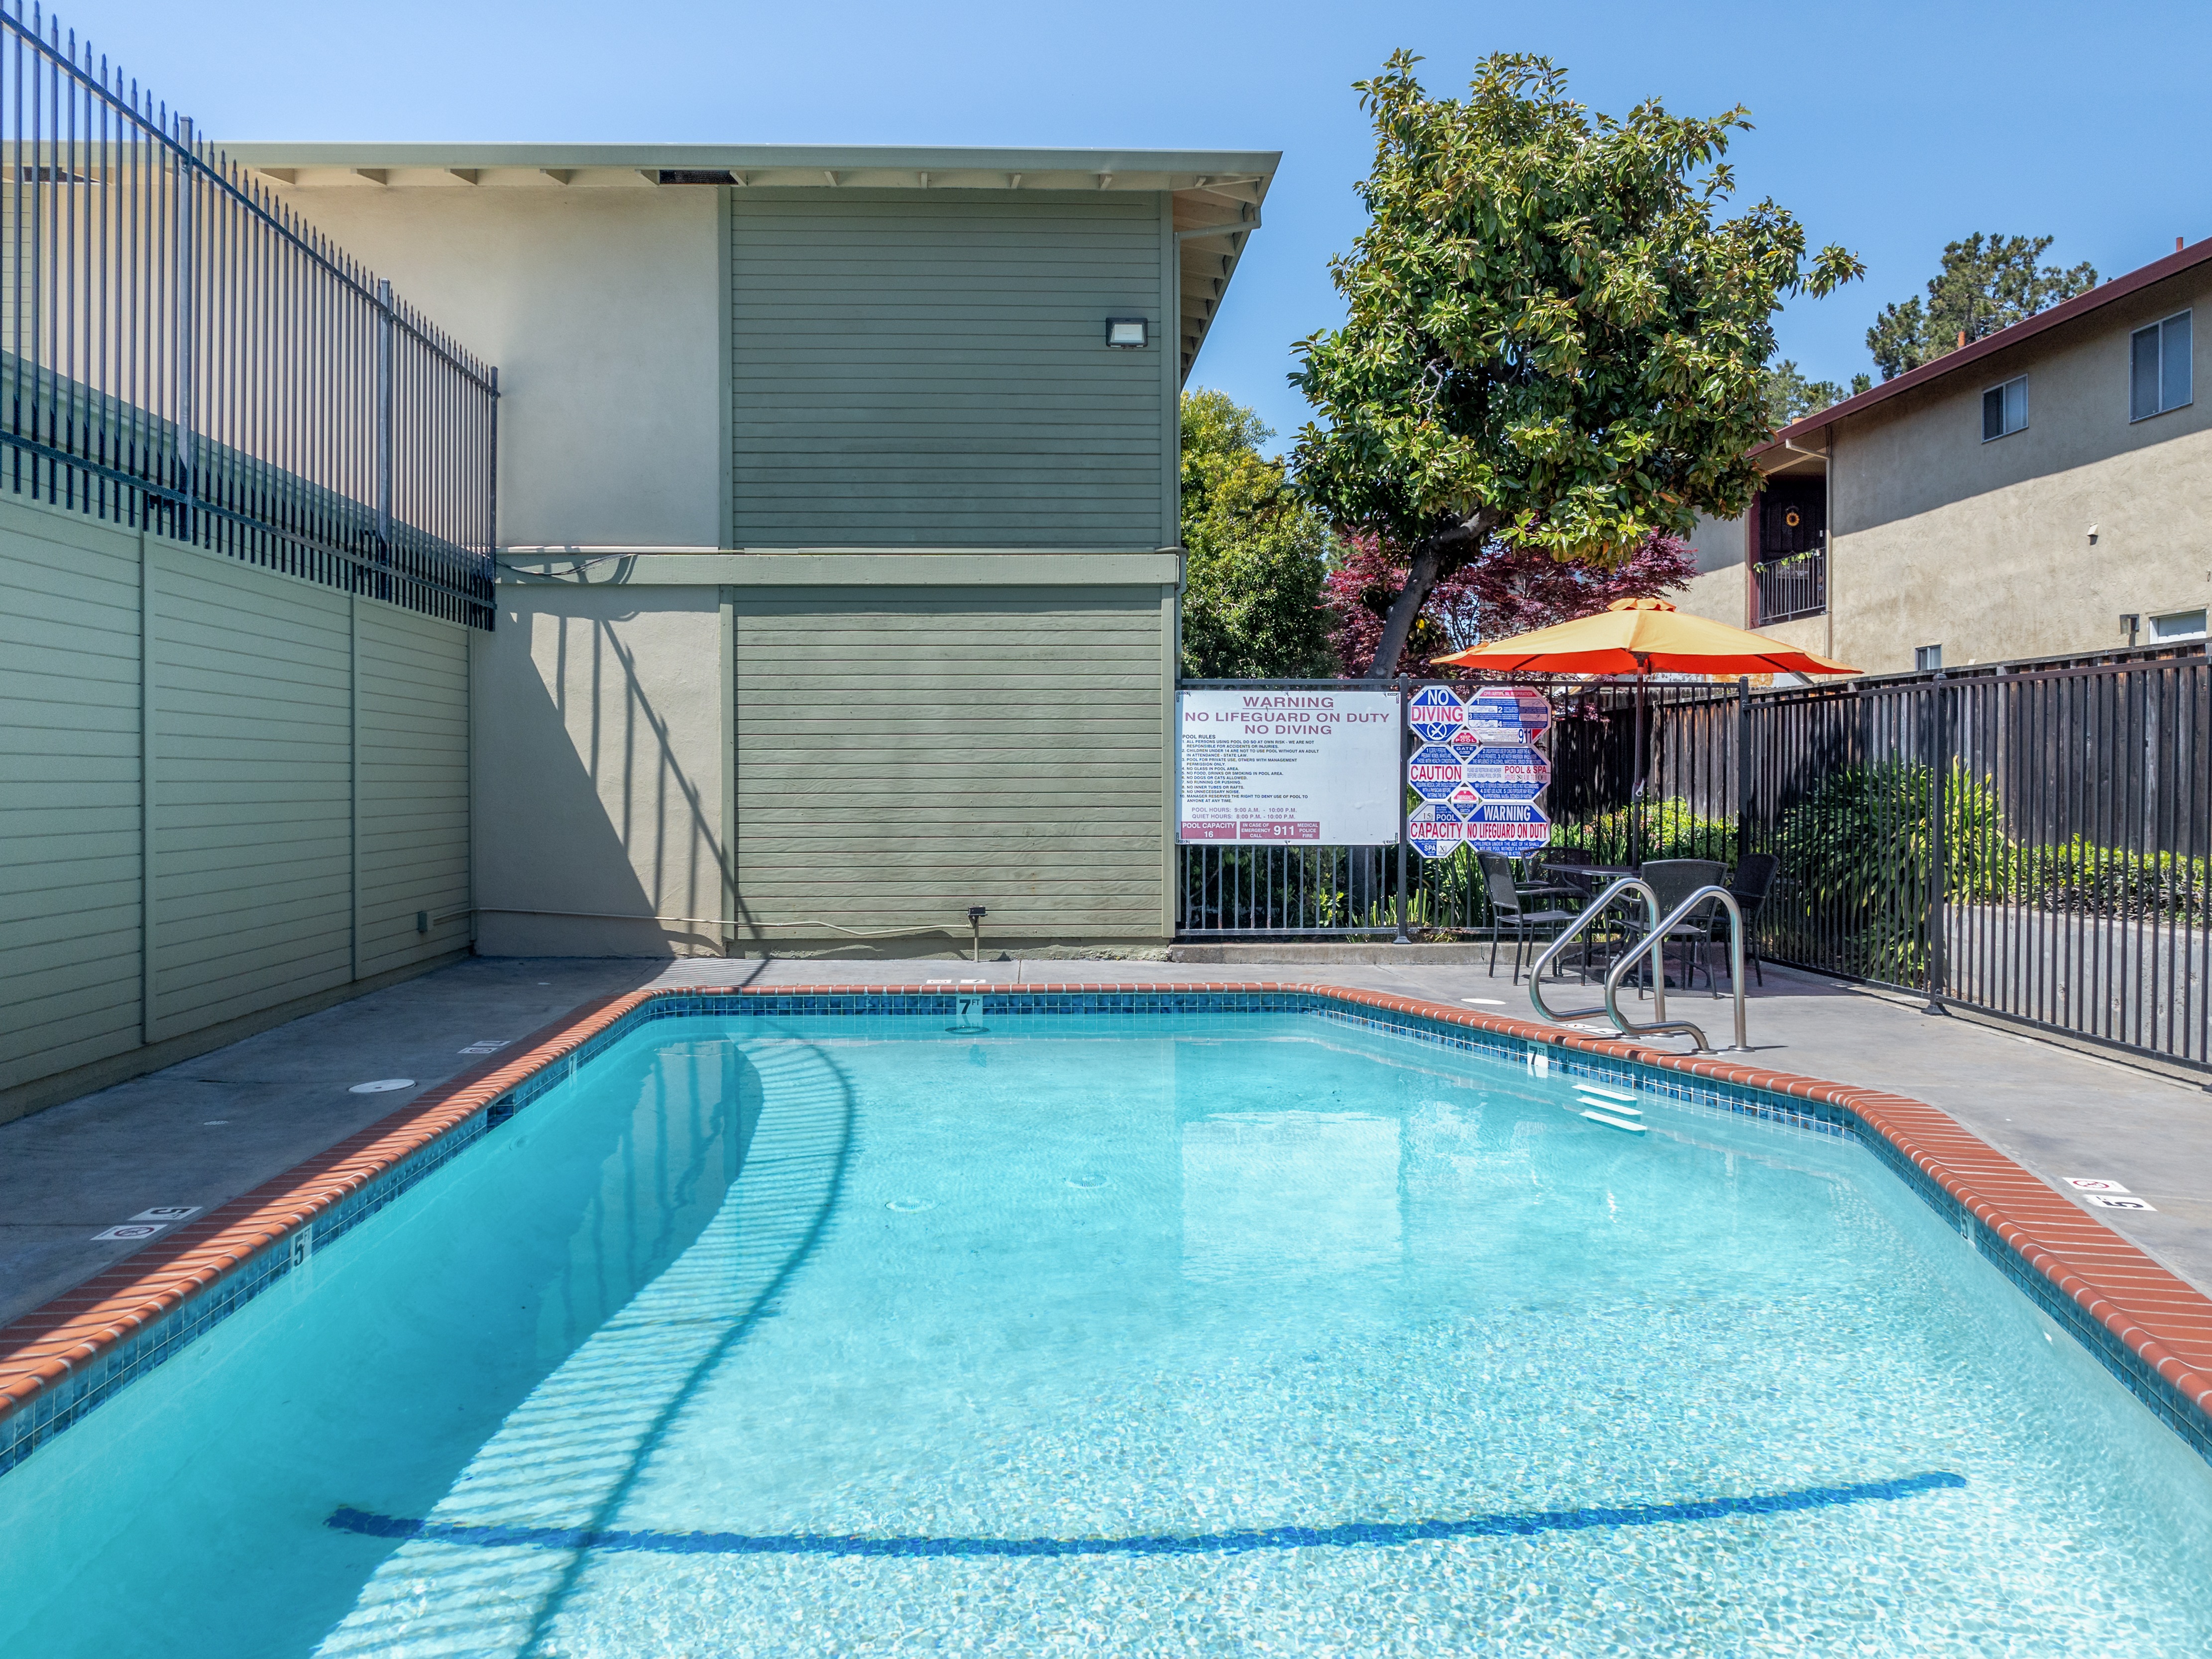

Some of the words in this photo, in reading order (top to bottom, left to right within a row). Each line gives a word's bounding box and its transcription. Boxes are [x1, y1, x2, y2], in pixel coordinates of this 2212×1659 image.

[1243, 697, 1333, 708] WARNING
[1428, 690, 1449, 705] NO
[1186, 712, 1209, 721] NO
[1216, 712, 1310, 722] LIFEGUARD
[1317, 713, 1340, 722] ON
[1347, 713, 1389, 722] DUTY
[1412, 707, 1463, 722] DIVING
[1245, 725, 1269, 734] NO
[1276, 725, 1331, 734] DIVING
[1519, 729, 1532, 744] 911
[1411, 766, 1461, 780] CAUTION
[1484, 806, 1531, 821] WARNING
[1274, 826, 1294, 835] 911
[1411, 823, 1463, 838] CAPACITY
[1467, 823, 1477, 838] NO
[1480, 823, 1515, 838] LIFEGUARD
[1518, 823, 1527, 838] ON
[1530, 823, 1547, 838] DUTY
[960, 999, 971, 1014] 7
[1529, 1046, 1538, 1065] 7
[294, 1232, 304, 1267] 5
[304, 1227, 311, 1242] FT
